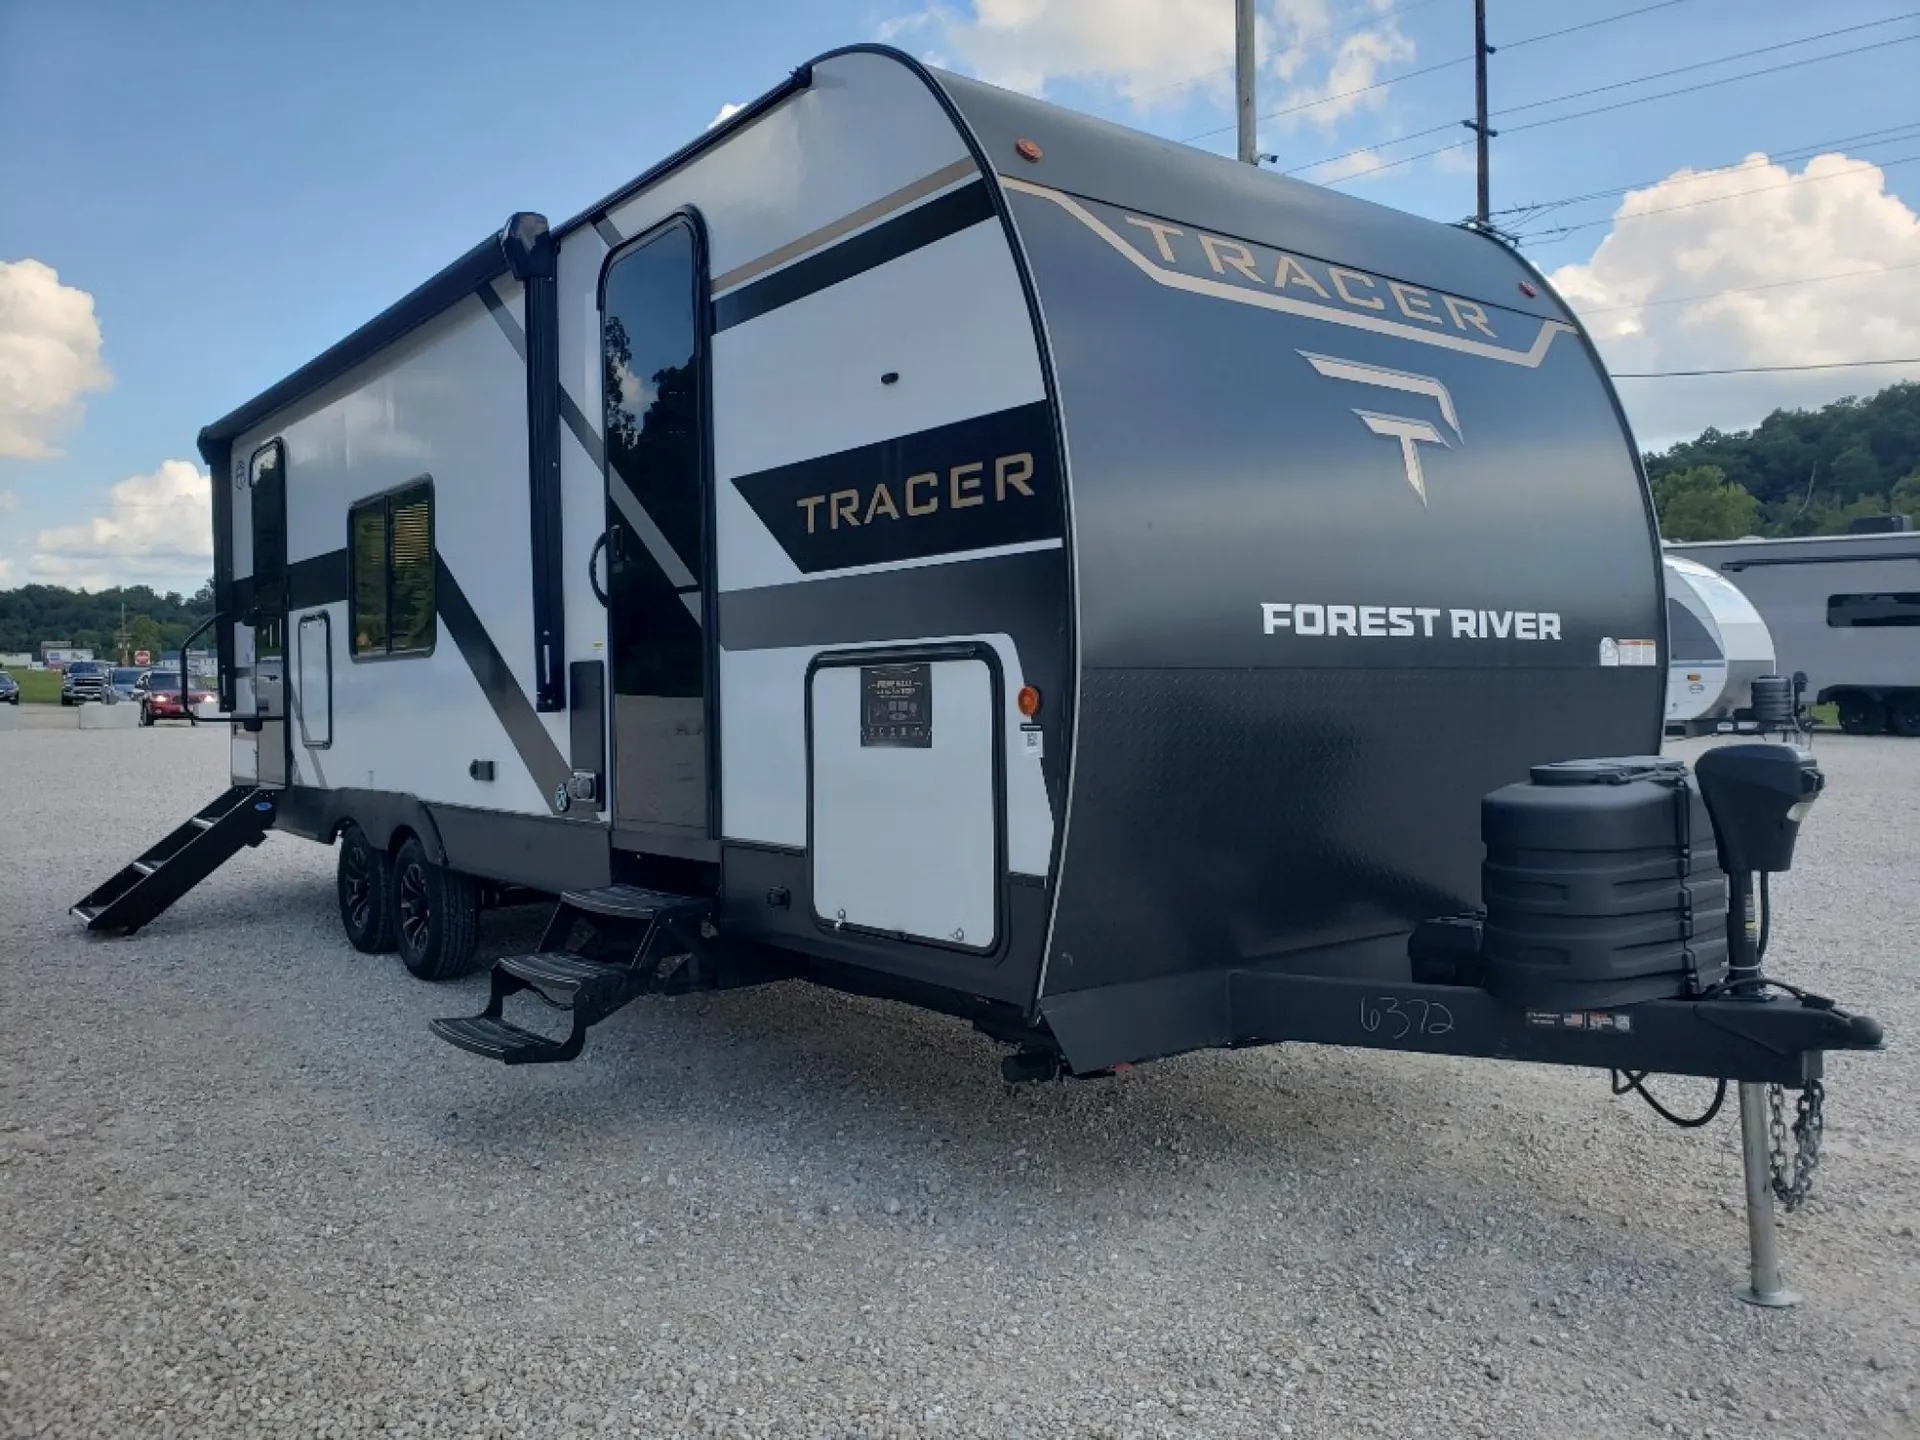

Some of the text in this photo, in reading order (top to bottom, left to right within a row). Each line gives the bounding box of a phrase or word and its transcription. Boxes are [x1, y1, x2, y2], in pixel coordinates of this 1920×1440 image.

[1125, 215, 1497, 338] TRACER
[796, 452, 1035, 535] TRACER
[1260, 603, 1562, 640] FOREST RIVER
[1360, 996, 1455, 1039] 6372
